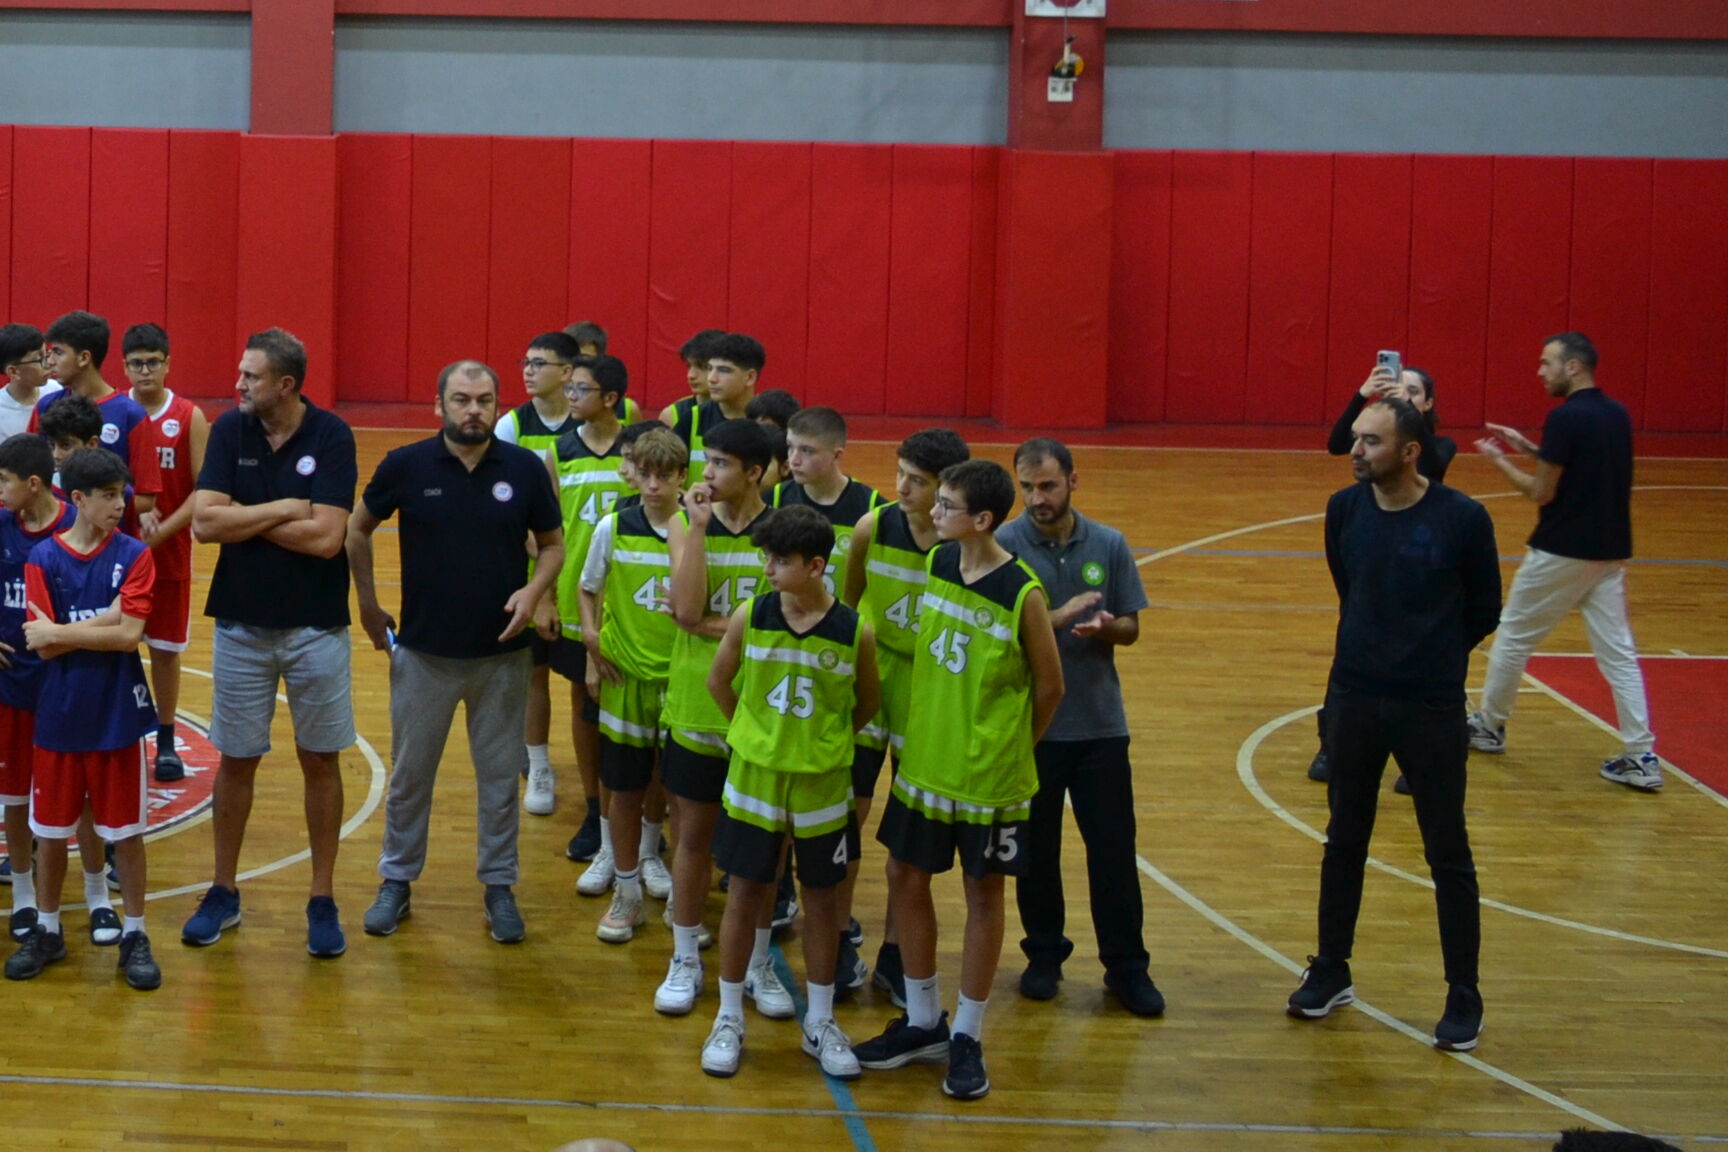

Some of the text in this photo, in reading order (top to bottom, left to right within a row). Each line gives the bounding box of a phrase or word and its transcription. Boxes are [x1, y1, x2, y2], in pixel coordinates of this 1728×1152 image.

[928, 626, 971, 675] 45
[132, 683, 149, 708] 12
[764, 673, 815, 720] 45
